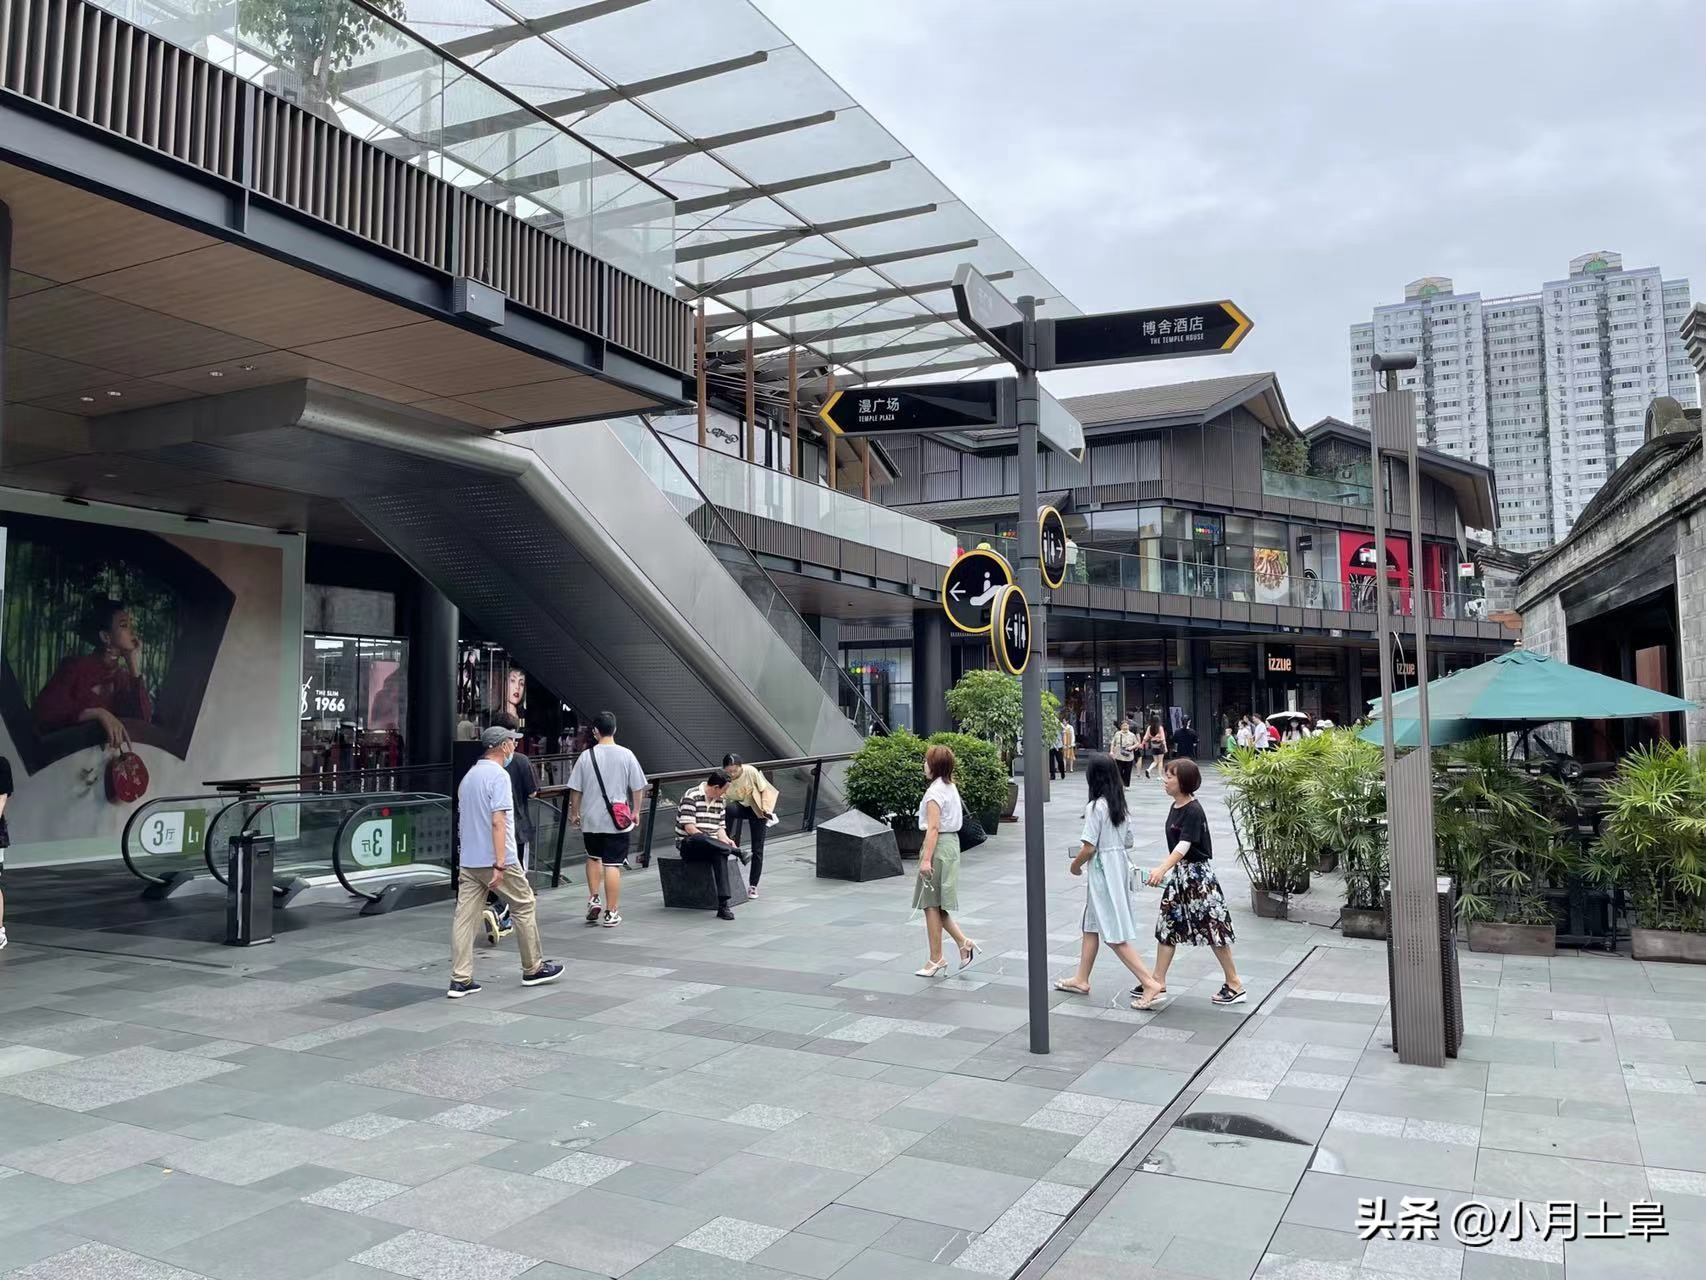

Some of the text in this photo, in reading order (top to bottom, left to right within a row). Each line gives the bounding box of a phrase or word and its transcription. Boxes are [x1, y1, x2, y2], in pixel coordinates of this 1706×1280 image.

[1142, 316, 1204, 336] 博舍酒店
[1150, 333, 1204, 345] THE TEMPLE HOUSE
[858, 396, 900, 414] 漫广场
[858, 414, 878, 422] TEMPLE
[1268, 652, 1292, 672] izzue
[1396, 659, 1415, 675] izzue
[314, 696, 346, 712] 1966
